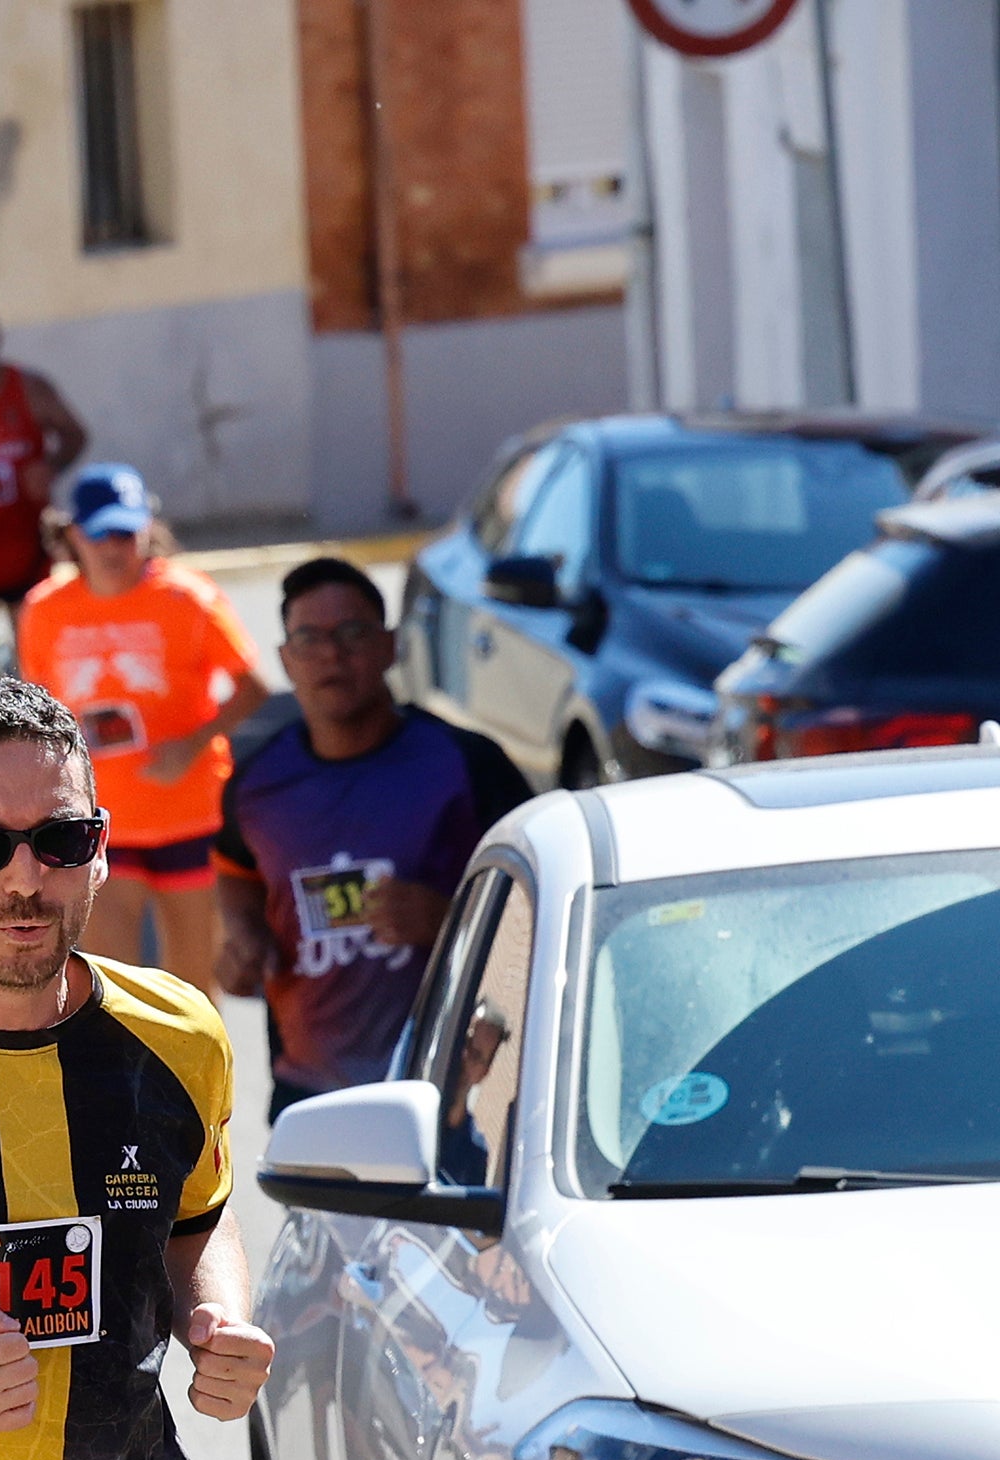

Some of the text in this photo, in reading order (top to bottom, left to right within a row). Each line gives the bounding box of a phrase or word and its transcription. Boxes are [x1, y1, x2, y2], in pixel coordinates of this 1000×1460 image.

[105, 1174, 158, 1185] CARRERA
[106, 1186, 159, 1197] VACCEA
[107, 1199, 159, 1210] LA CIUDAD
[24, 1307, 89, 1336] ALOBÓN
